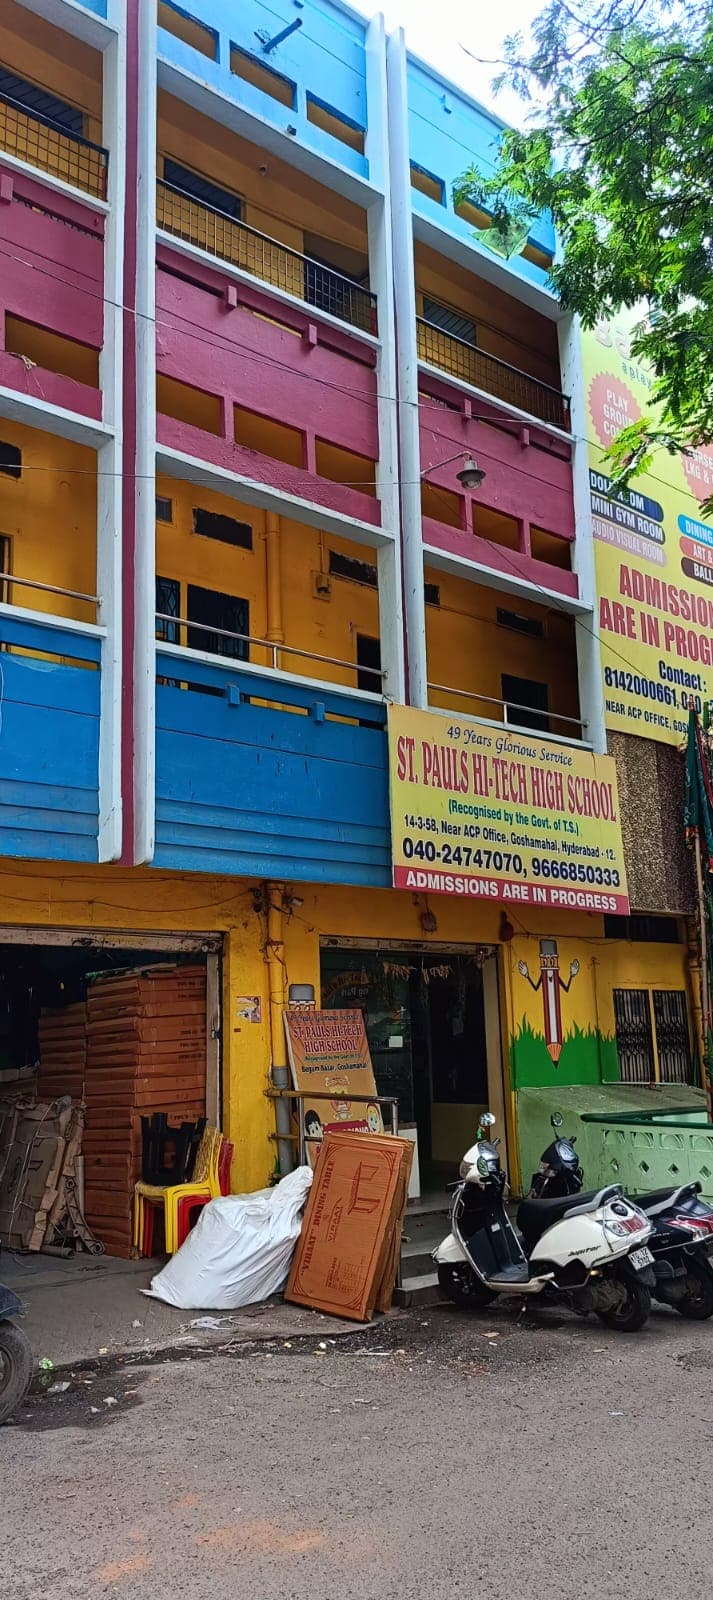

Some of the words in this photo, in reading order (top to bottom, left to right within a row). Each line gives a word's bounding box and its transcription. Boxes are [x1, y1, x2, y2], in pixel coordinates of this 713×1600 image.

[606, 389, 629, 412] PLAY
[591, 495, 613, 517] MINI
[615, 506, 636, 529] GYM
[637, 519, 664, 542] ROOM
[685, 520, 713, 545] DINING
[617, 528, 641, 554] VISUAL
[642, 542, 664, 564] ROOM
[693, 544, 706, 561] ART
[600, 597, 637, 640] ARE
[640, 611, 660, 648] IN
[664, 621, 713, 667] PROG
[658, 660, 703, 692] Contact
[605, 699, 626, 716] NEAR
[627, 706, 642, 720] ACP
[644, 710, 672, 731] OFFICE,
[447, 726, 461, 739] 49
[464, 729, 492, 747] Years
[495, 737, 537, 758] Glorious
[539, 748, 573, 766] Service
[397, 735, 418, 784] ST.
[421, 741, 469, 794] PAULS
[471, 753, 529, 805] HI-TECH
[530, 766, 565, 812] HIGH
[567, 774, 617, 822] SCHOOL
[404, 814, 439, 835] 14-3-58,
[441, 820, 462, 836] Near
[464, 824, 481, 838] ACP
[482, 827, 509, 845] Office,
[510, 832, 560, 854] Goshamahal,
[561, 840, 600, 858] Hyderabad
[448, 798, 502, 820] (Recognised
[504, 809, 514, 826] by
[515, 812, 529, 826] the
[531, 814, 552, 829] Govt.
[553, 819, 561, 831] of
[562, 820, 579, 837] T.S.)
[402, 837, 528, 878] 040-24747070,
[531, 857, 620, 888] 9666850333
[406, 870, 499, 897] ADMISSIONS
[502, 883, 529, 900] ARE
[532, 887, 547, 903] IN
[550, 889, 617, 911] PROGRESS
[304, 1040, 326, 1053] HIGH
[327, 1039, 357, 1052] SCHOOL
[305, 1025, 331, 1038] PAULS
[332, 1024, 362, 1037] HI-TECH
[313, 1193, 328, 1226] DINING
[321, 1159, 336, 1191] TABLE
